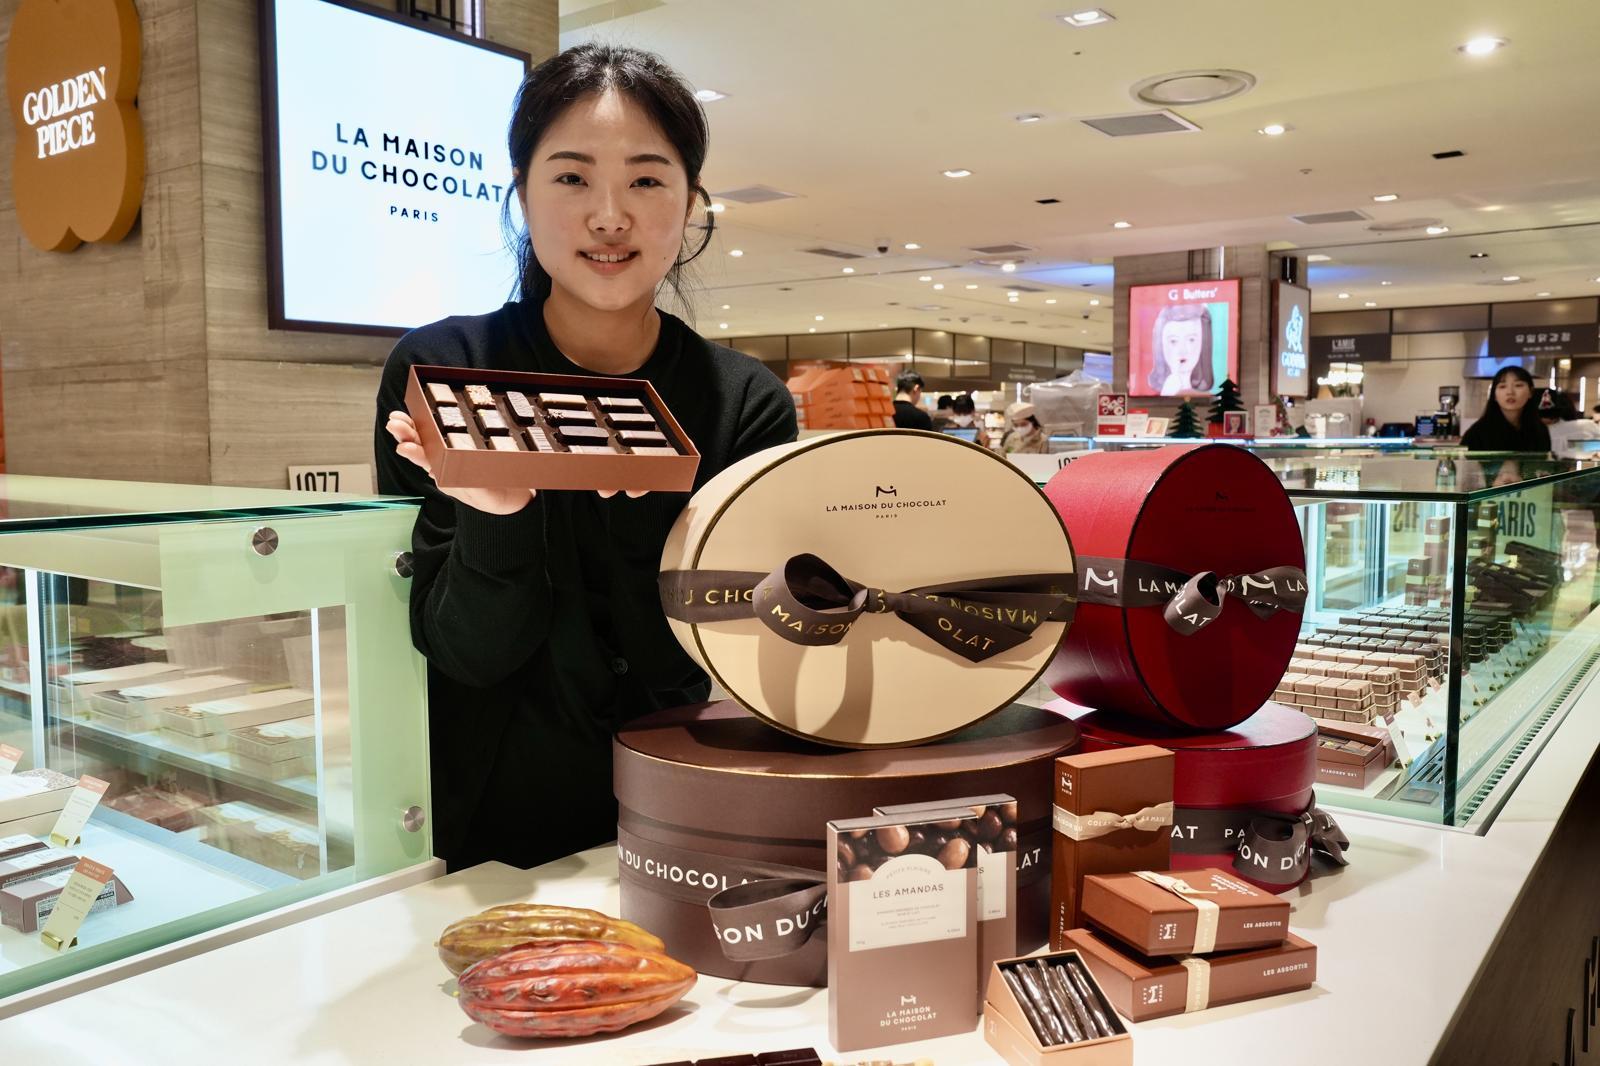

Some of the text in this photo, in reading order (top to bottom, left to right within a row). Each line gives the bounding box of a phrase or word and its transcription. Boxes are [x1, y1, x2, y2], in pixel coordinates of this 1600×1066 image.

[23, 66, 106, 125] GOLDEN
[37, 111, 96, 159] PIECE
[336, 123, 483, 170] LA MAISON
[312, 151, 503, 202] DU CHOCOLAT
[390, 206, 439, 222] PARIS
[841, 503, 877, 511] MAISON
[896, 499, 947, 508] CHOCOLAT
[1138, 577, 1160, 593] LA
[1286, 579, 1307, 592] LA
[938, 617, 995, 651] OLAT
[626, 850, 640, 870] DU
[873, 884, 944, 899] LES AMANDAS
[776, 911, 810, 936] DU
[880, 1012, 937, 1027] DU CHOCOLAT
[899, 1005, 931, 1017] MAISON
